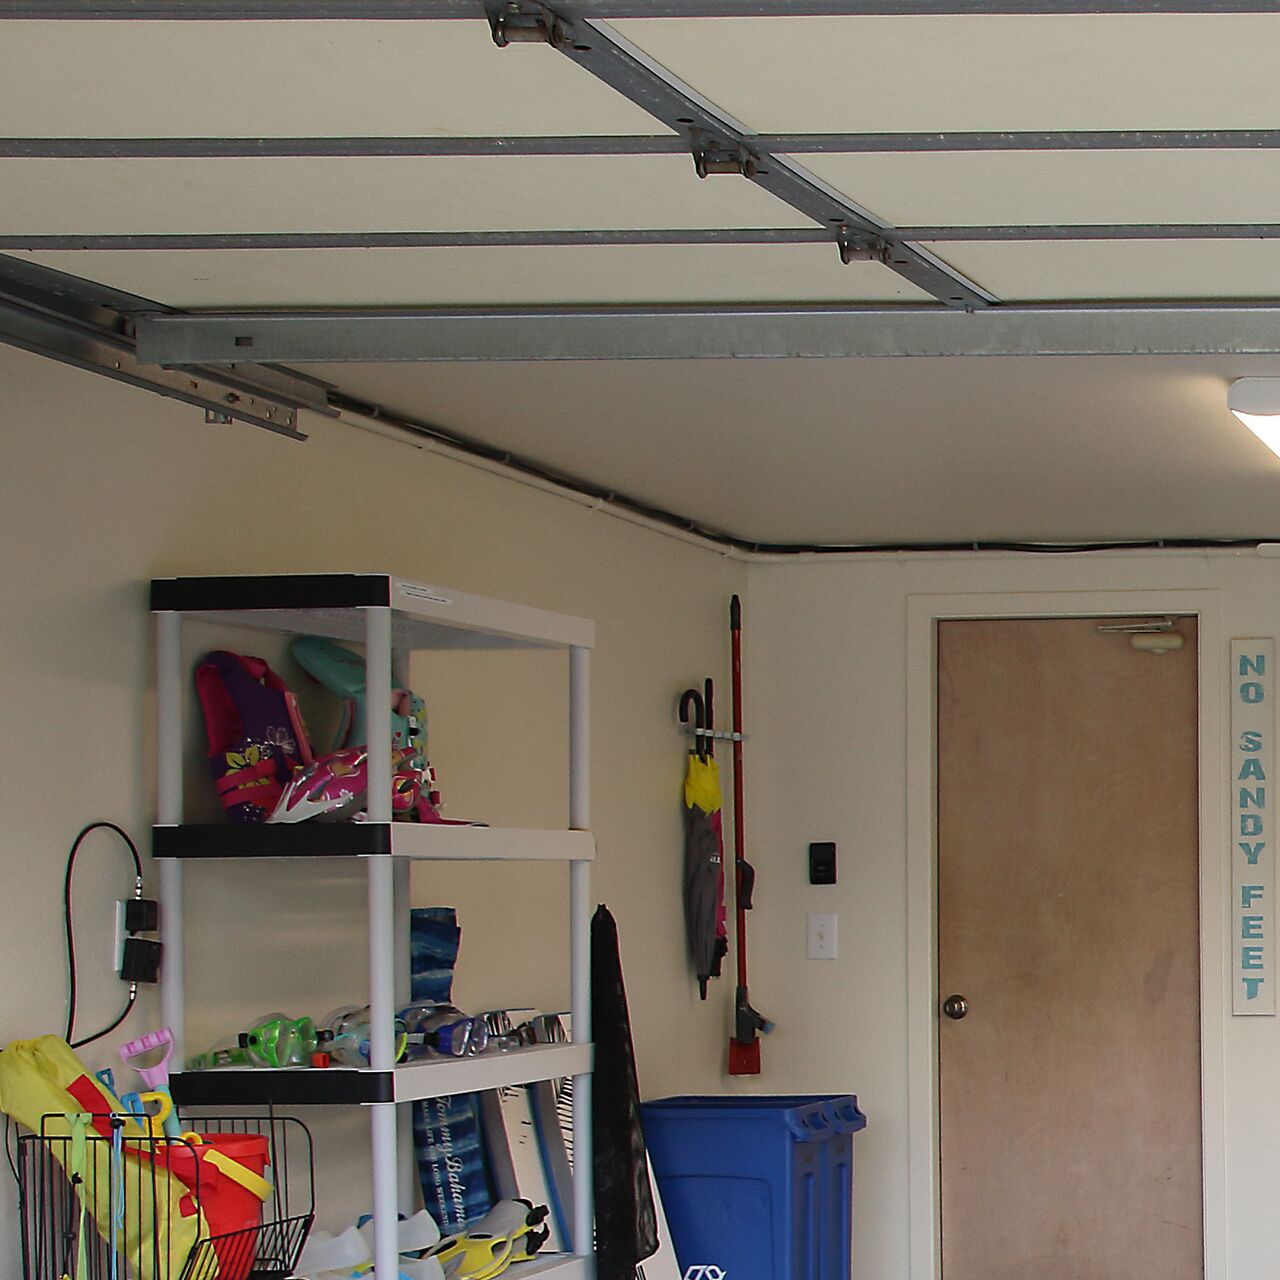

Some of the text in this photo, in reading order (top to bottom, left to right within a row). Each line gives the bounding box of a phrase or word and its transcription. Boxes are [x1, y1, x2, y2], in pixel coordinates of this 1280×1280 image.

[1238, 655, 1266, 1000] NO SANDY FEET
[436, 1096, 453, 1158] Tommy
